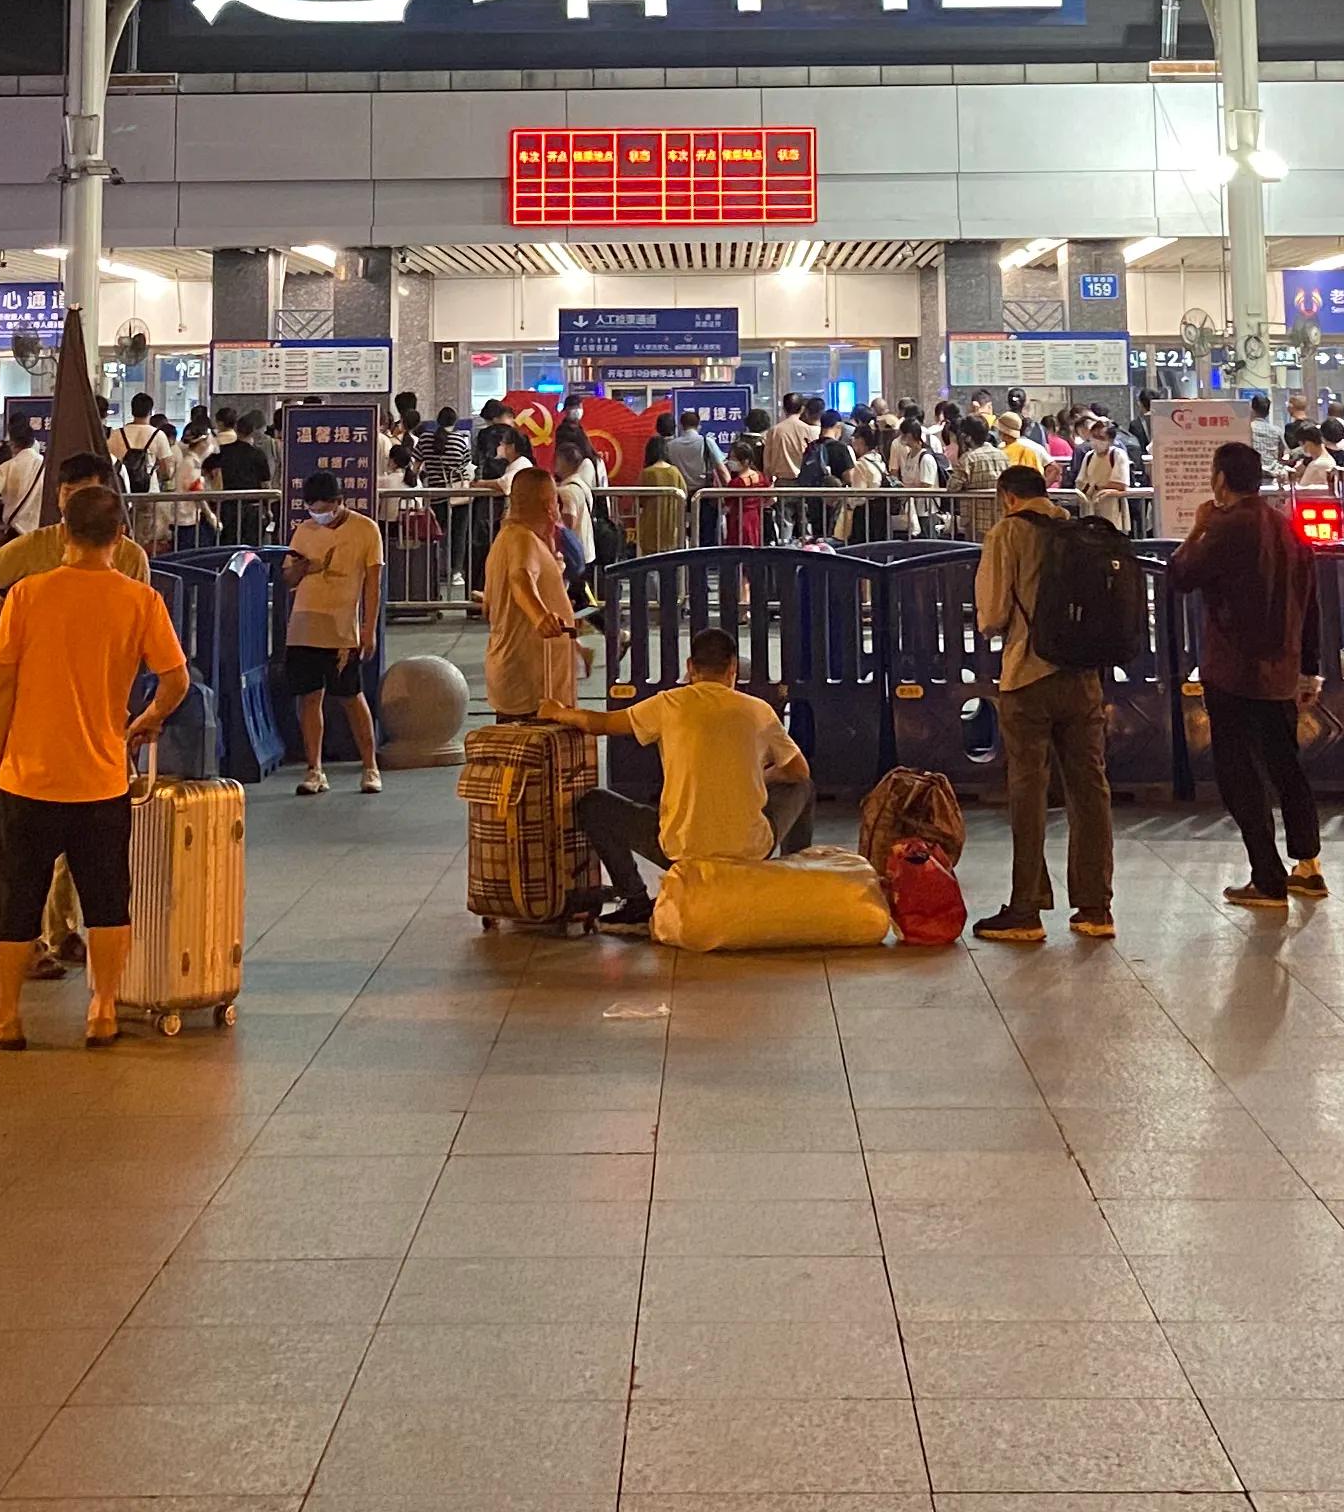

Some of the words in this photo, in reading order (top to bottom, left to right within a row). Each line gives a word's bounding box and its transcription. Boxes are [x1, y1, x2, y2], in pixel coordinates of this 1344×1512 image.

[1088, 283, 1112, 296] 159
[296, 426, 369, 443] 温馨提示
